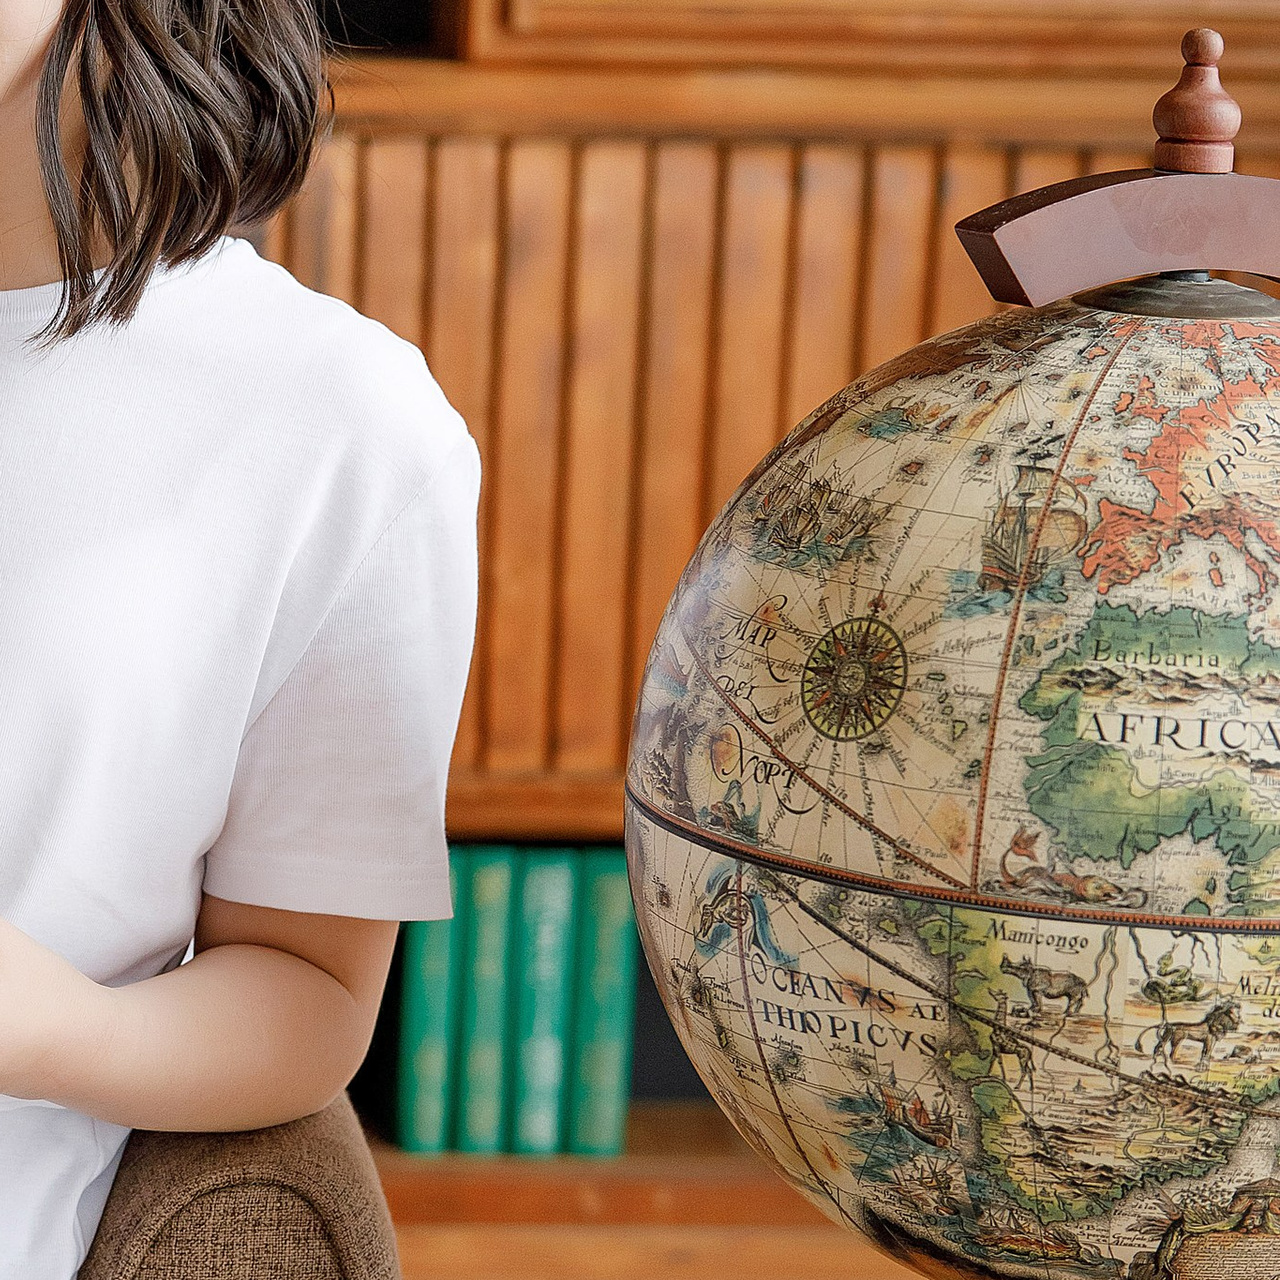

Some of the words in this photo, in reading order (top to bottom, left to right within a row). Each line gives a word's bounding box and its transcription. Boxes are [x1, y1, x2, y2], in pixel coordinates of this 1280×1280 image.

[1092, 638, 1221, 669] Barbaria
[1078, 712, 1280, 752] AFRICA
[984, 918, 1089, 955] Manicongo
[751, 952, 897, 1015] OCEANVS
